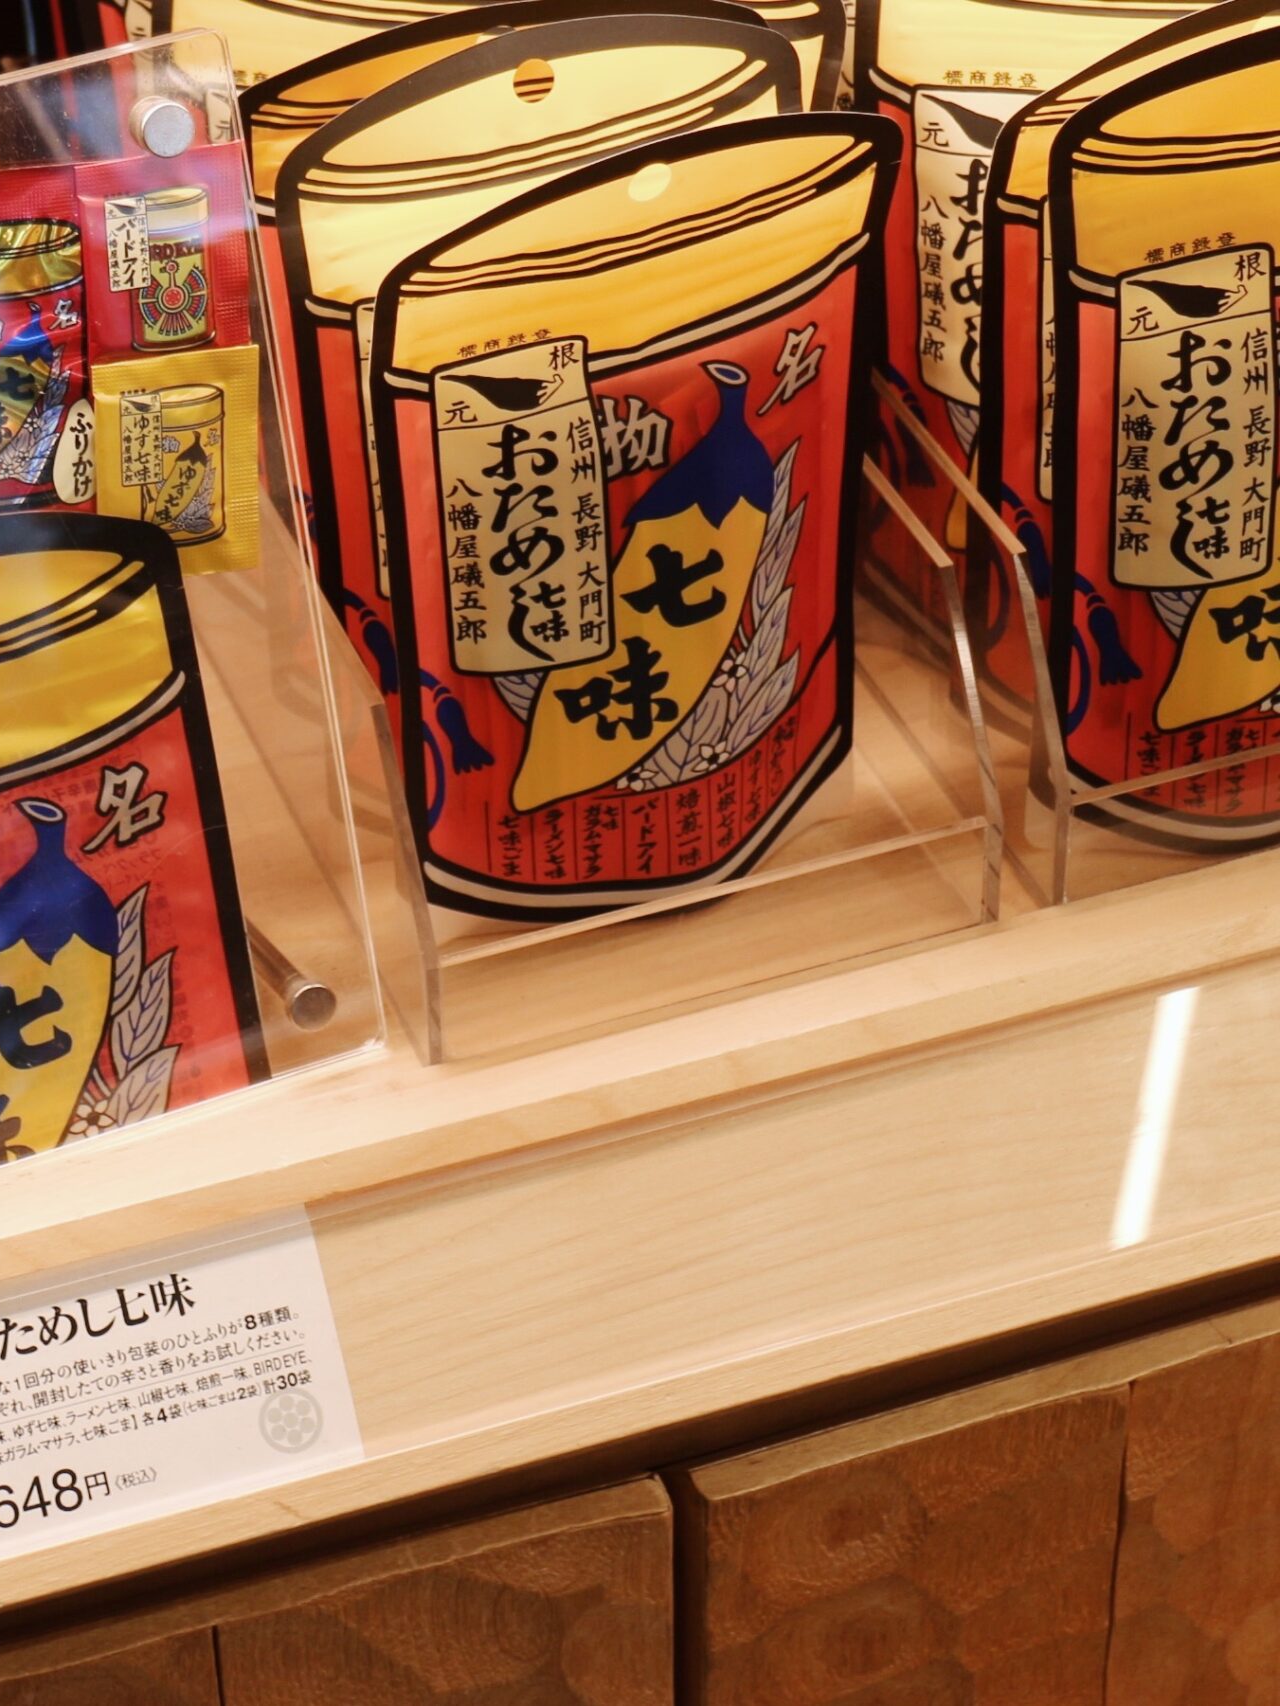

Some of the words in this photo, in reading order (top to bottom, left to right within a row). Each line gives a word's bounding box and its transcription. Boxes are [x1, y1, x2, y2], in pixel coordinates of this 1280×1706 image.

[921, 122, 951, 148] 元
[115, 217, 138, 287] バードアイ
[1233, 251, 1267, 283] 根
[49, 299, 80, 331] 名
[1126, 305, 1160, 336] 元
[548, 342, 581, 372] 根
[757, 322, 826, 416] 名
[443, 400, 479, 425] 元
[597, 394, 674, 479] 物
[69, 413, 94, 498] ふりかけ
[133, 415, 151, 483] ゆず七味
[155, 465, 197, 522] ゆず七味
[553, 543, 728, 742] 七味
[81, 761, 167, 854] 名
[631, 797, 660, 873] バードアイ
